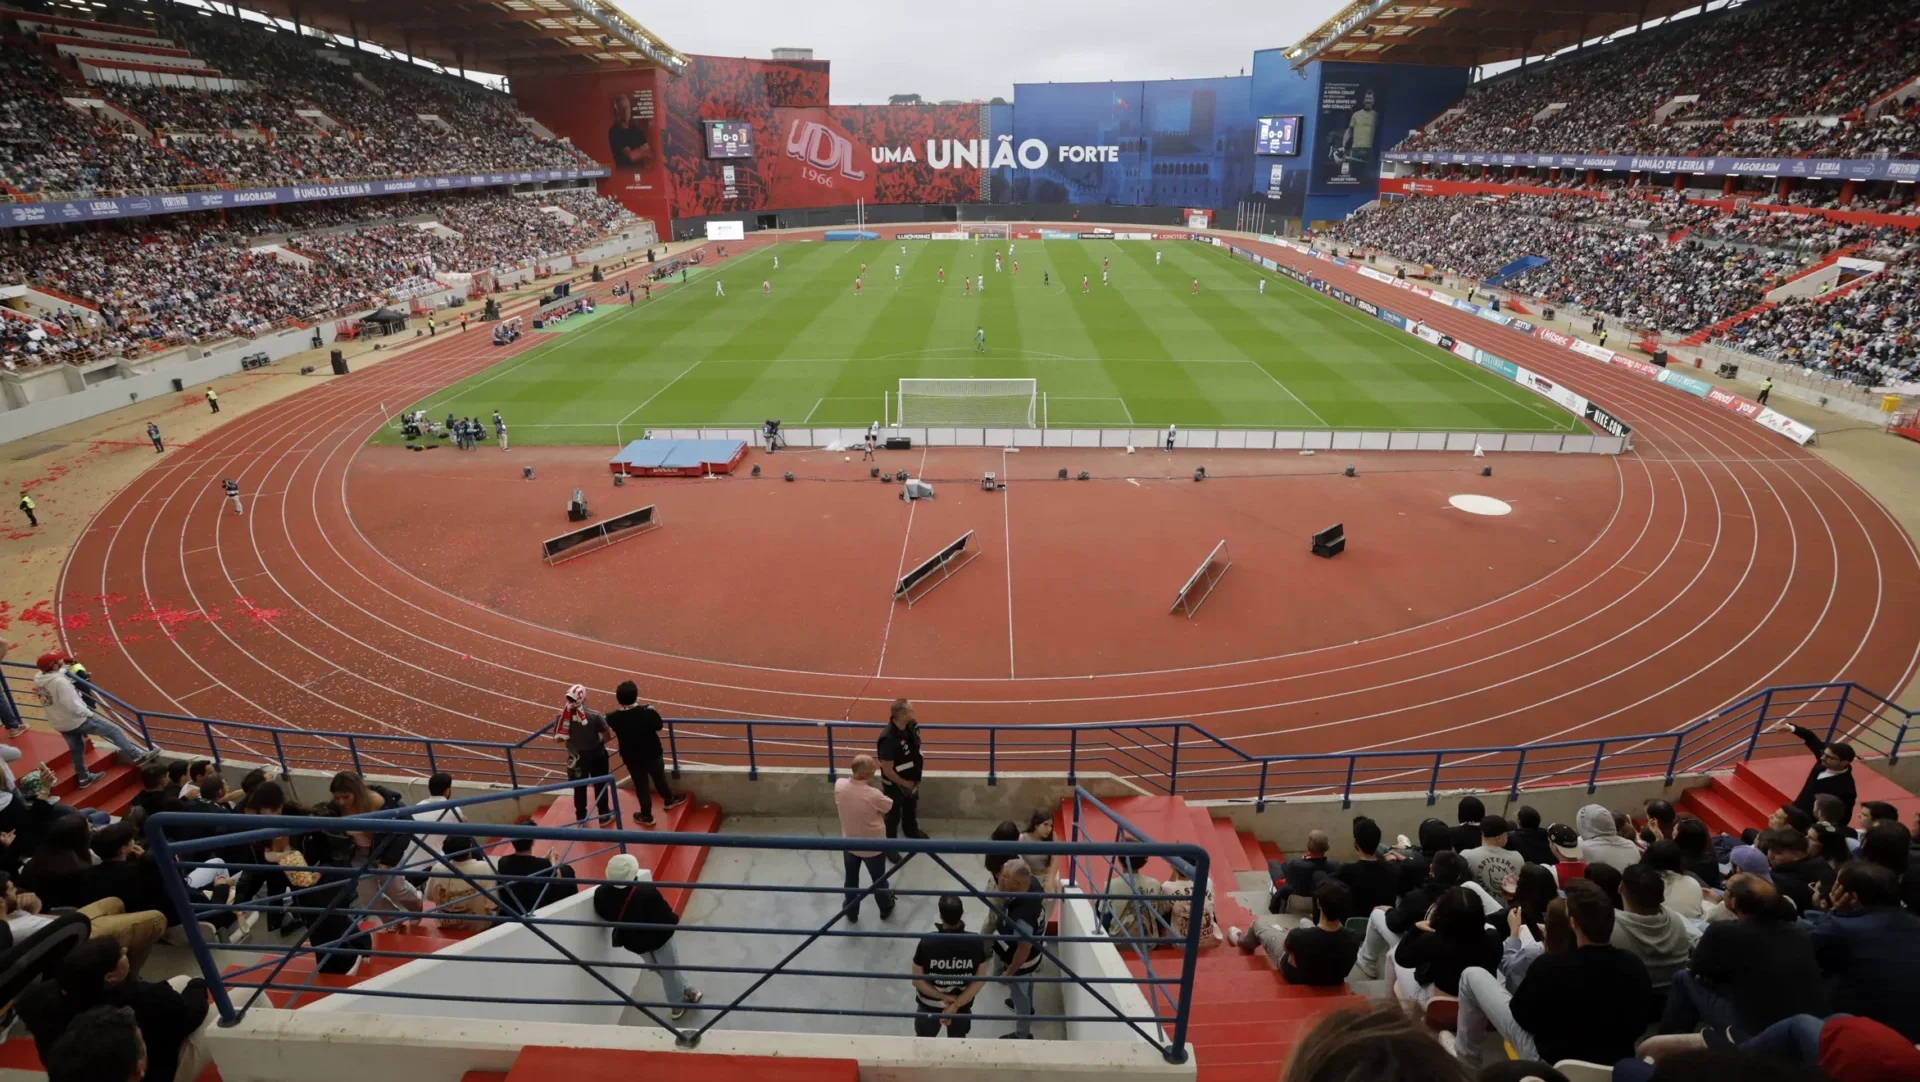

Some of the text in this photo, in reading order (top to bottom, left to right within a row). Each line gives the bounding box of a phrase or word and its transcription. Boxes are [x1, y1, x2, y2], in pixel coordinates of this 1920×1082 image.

[871, 134, 1120, 170] UMA UNIÃO FORTE
[1638, 159, 1705, 171] UNIÃO DE LEIRIA
[1732, 162, 1781, 172] #AGORASIM
[1816, 162, 1841, 171] LEIRIA
[801, 166, 834, 189] 1966
[234, 191, 277, 203] #AGORASIM
[301, 186, 365, 198] UNIÃO DE LEIRIA
[90, 201, 119, 211] LEIRIA
[1709, 390, 1757, 414] meal you
[1593, 409, 1623, 437] NIKE.COM
[1478, 857, 1517, 872] SPITFIRE
[930, 957, 973, 970] POLÍCIA
